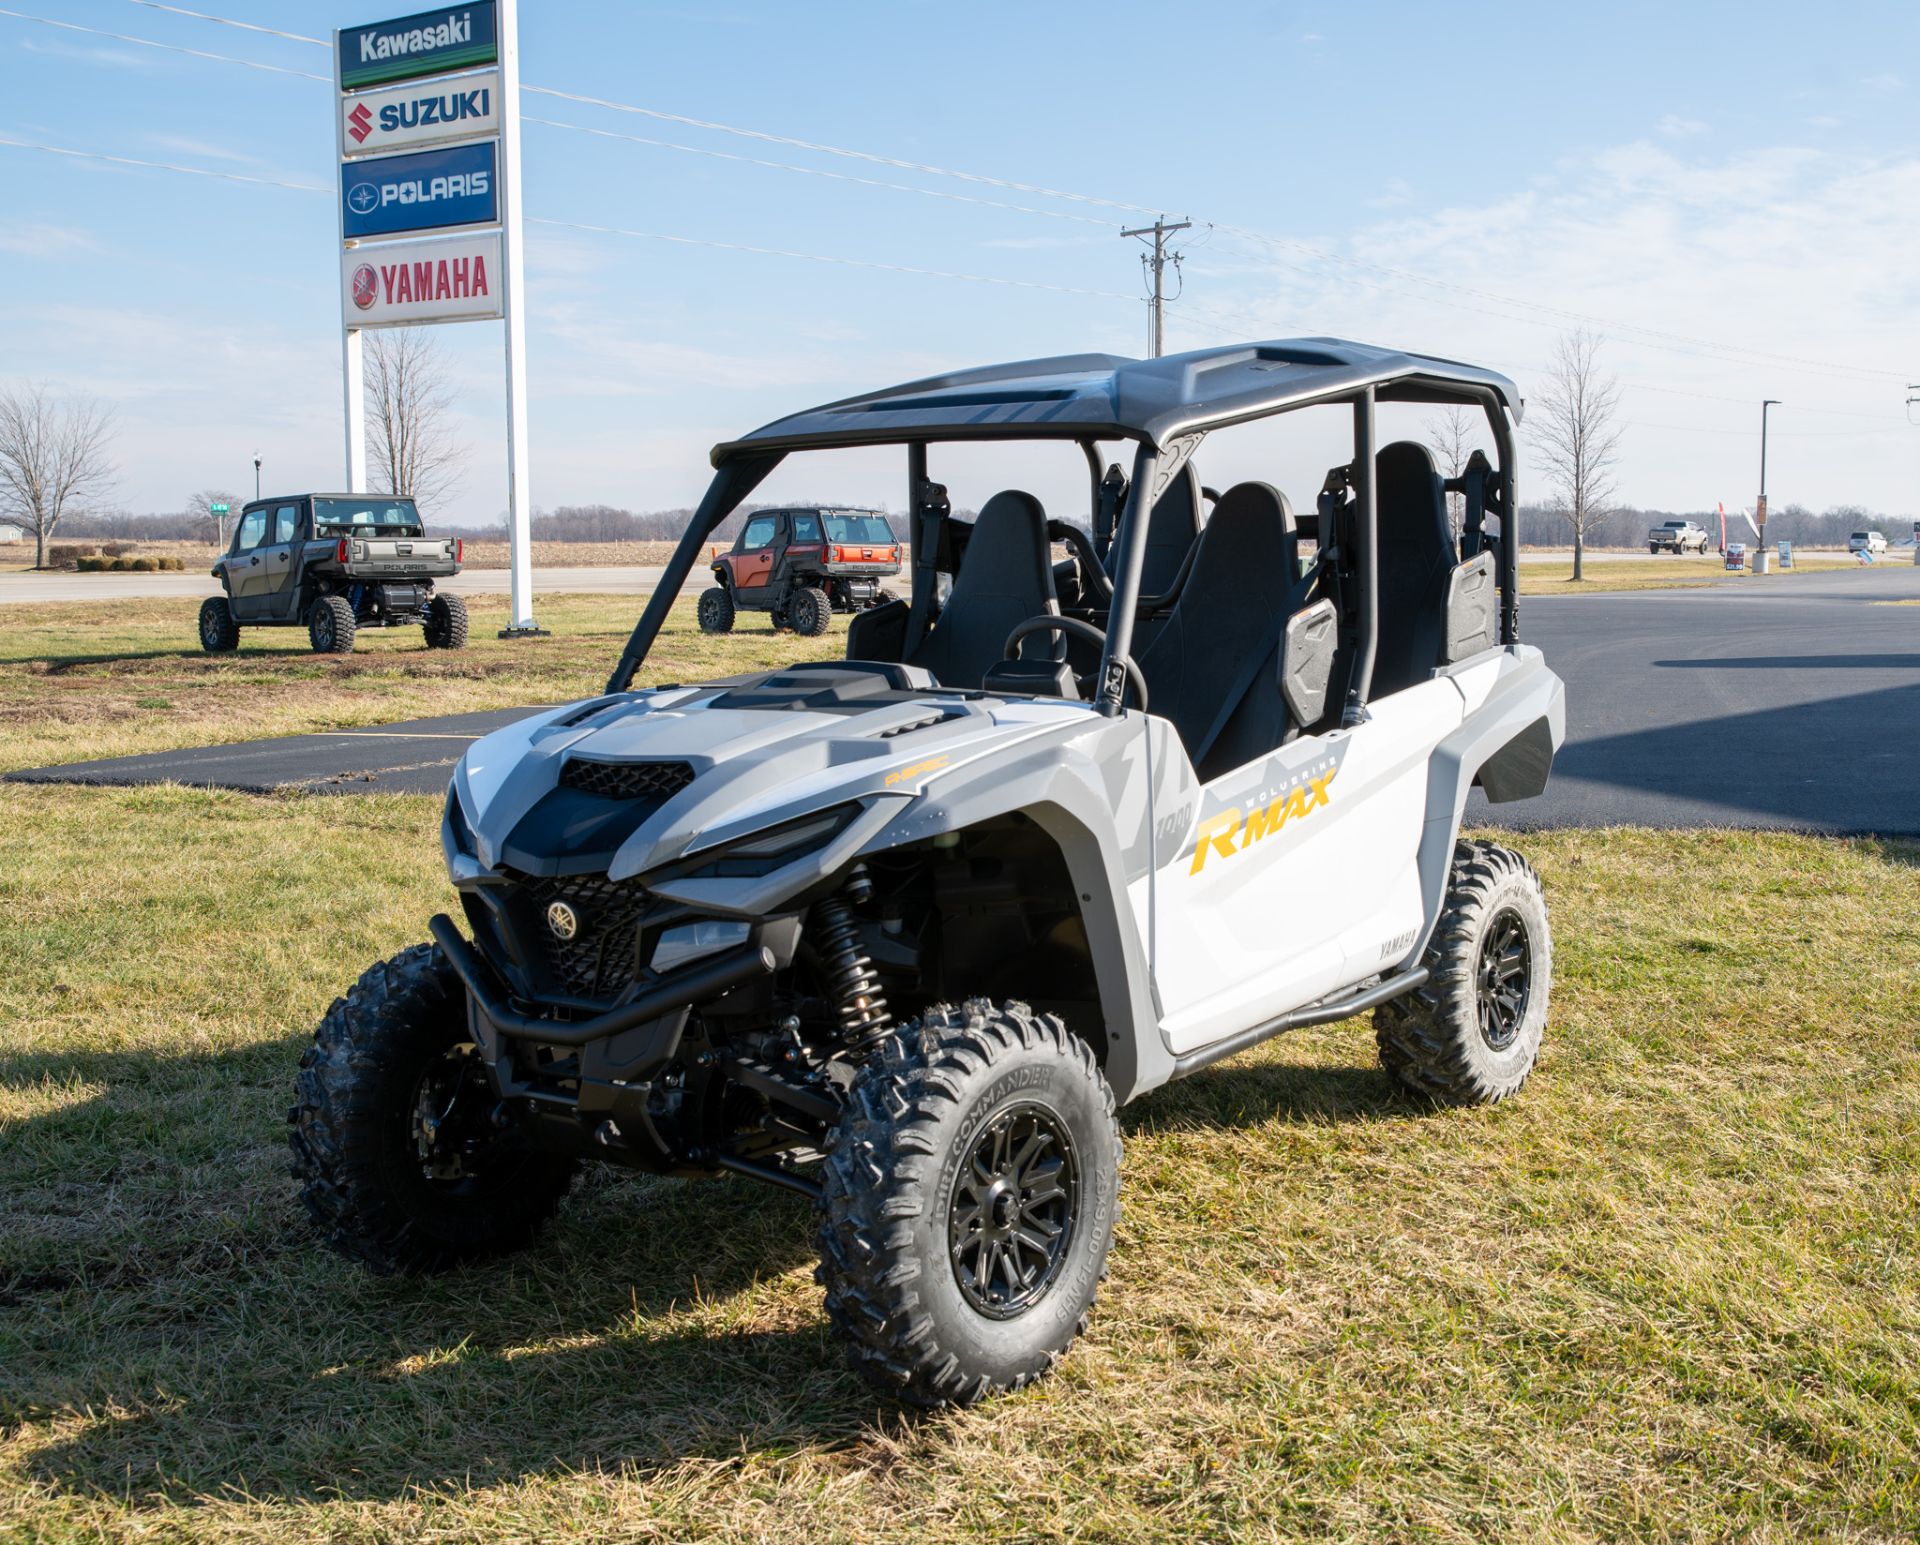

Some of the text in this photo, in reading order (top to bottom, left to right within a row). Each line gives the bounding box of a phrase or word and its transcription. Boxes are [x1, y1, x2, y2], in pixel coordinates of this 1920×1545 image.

[360, 12, 471, 62] Kawasaki
[379, 88, 490, 132] SUZUKI
[381, 171, 489, 207] POLARIS
[380, 255, 489, 305] YAMAHA
[383, 563, 428, 571] POLARIS
[1245, 755, 1337, 809] WOLVERINE
[1156, 801, 1193, 840] 1000
[1379, 928, 1417, 961] YAMAHA
[935, 1066, 1051, 1218] DIRT COMMANDER
